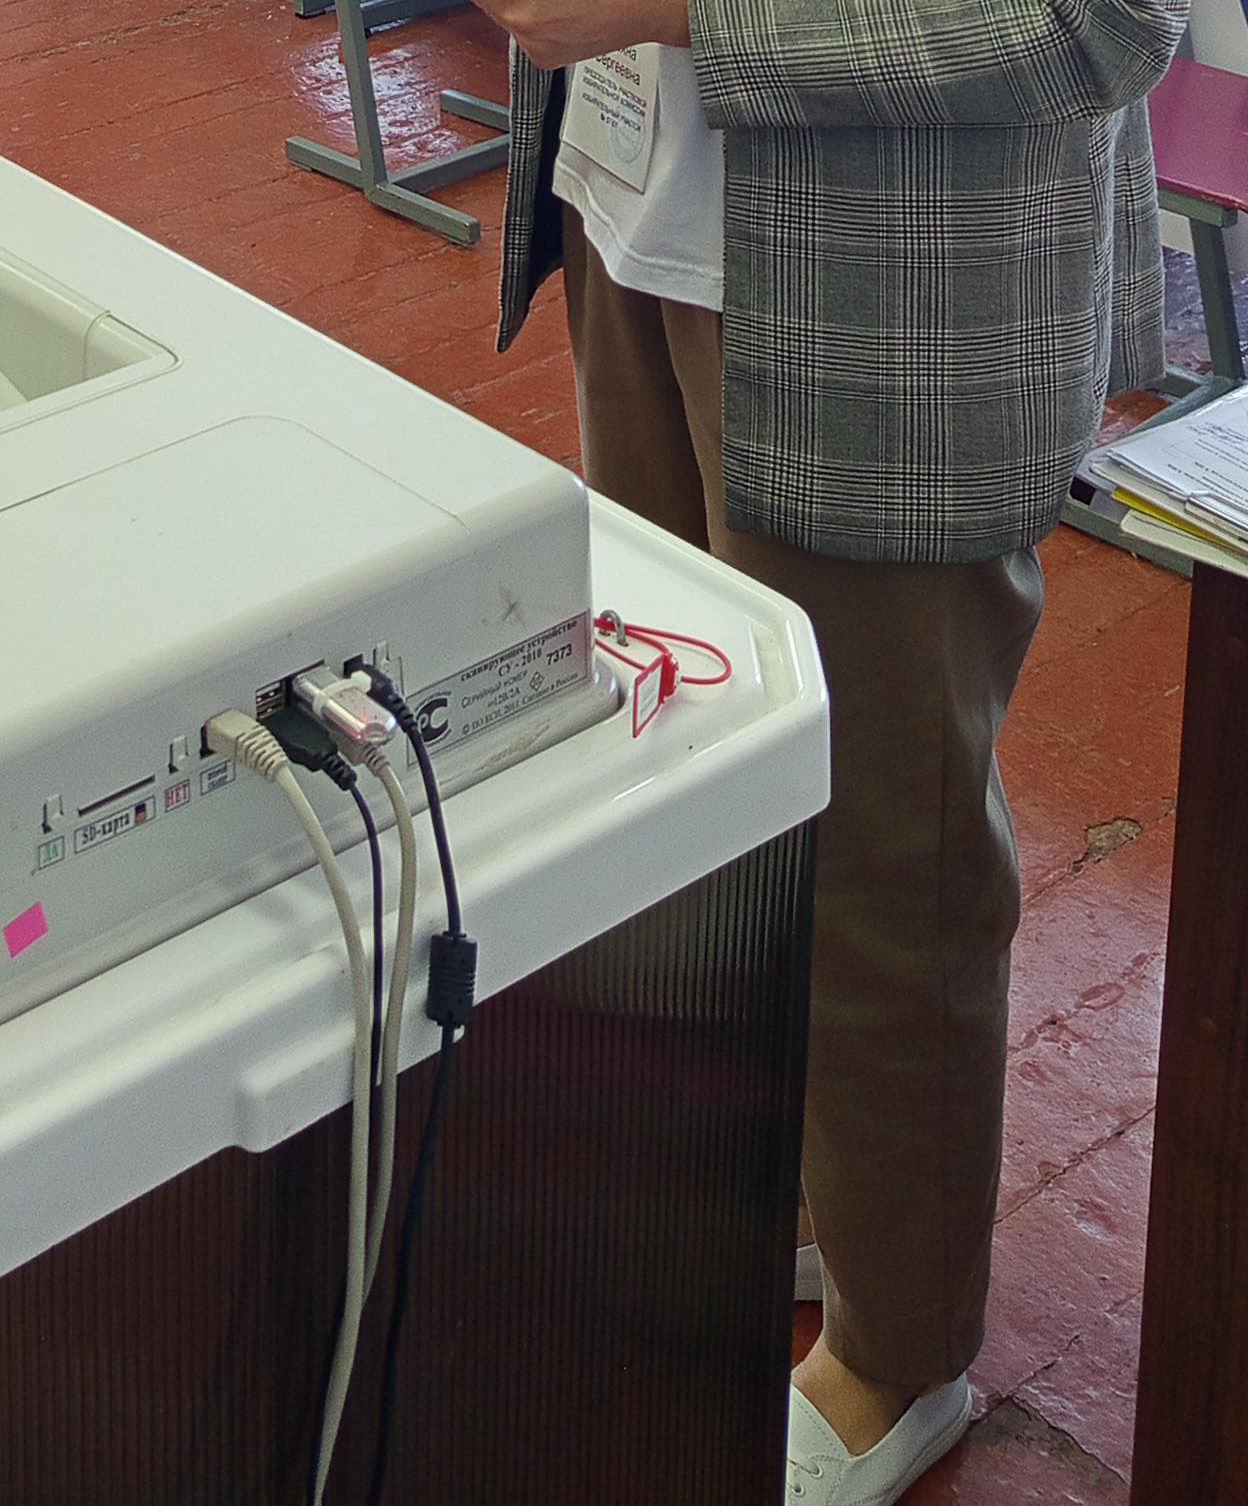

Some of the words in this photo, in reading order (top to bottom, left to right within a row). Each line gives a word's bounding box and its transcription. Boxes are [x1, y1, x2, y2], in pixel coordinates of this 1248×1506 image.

[521, 649, 543, 667] 2010
[546, 644, 573, 665] 7373
[82, 812, 130, 844] SD-карта
